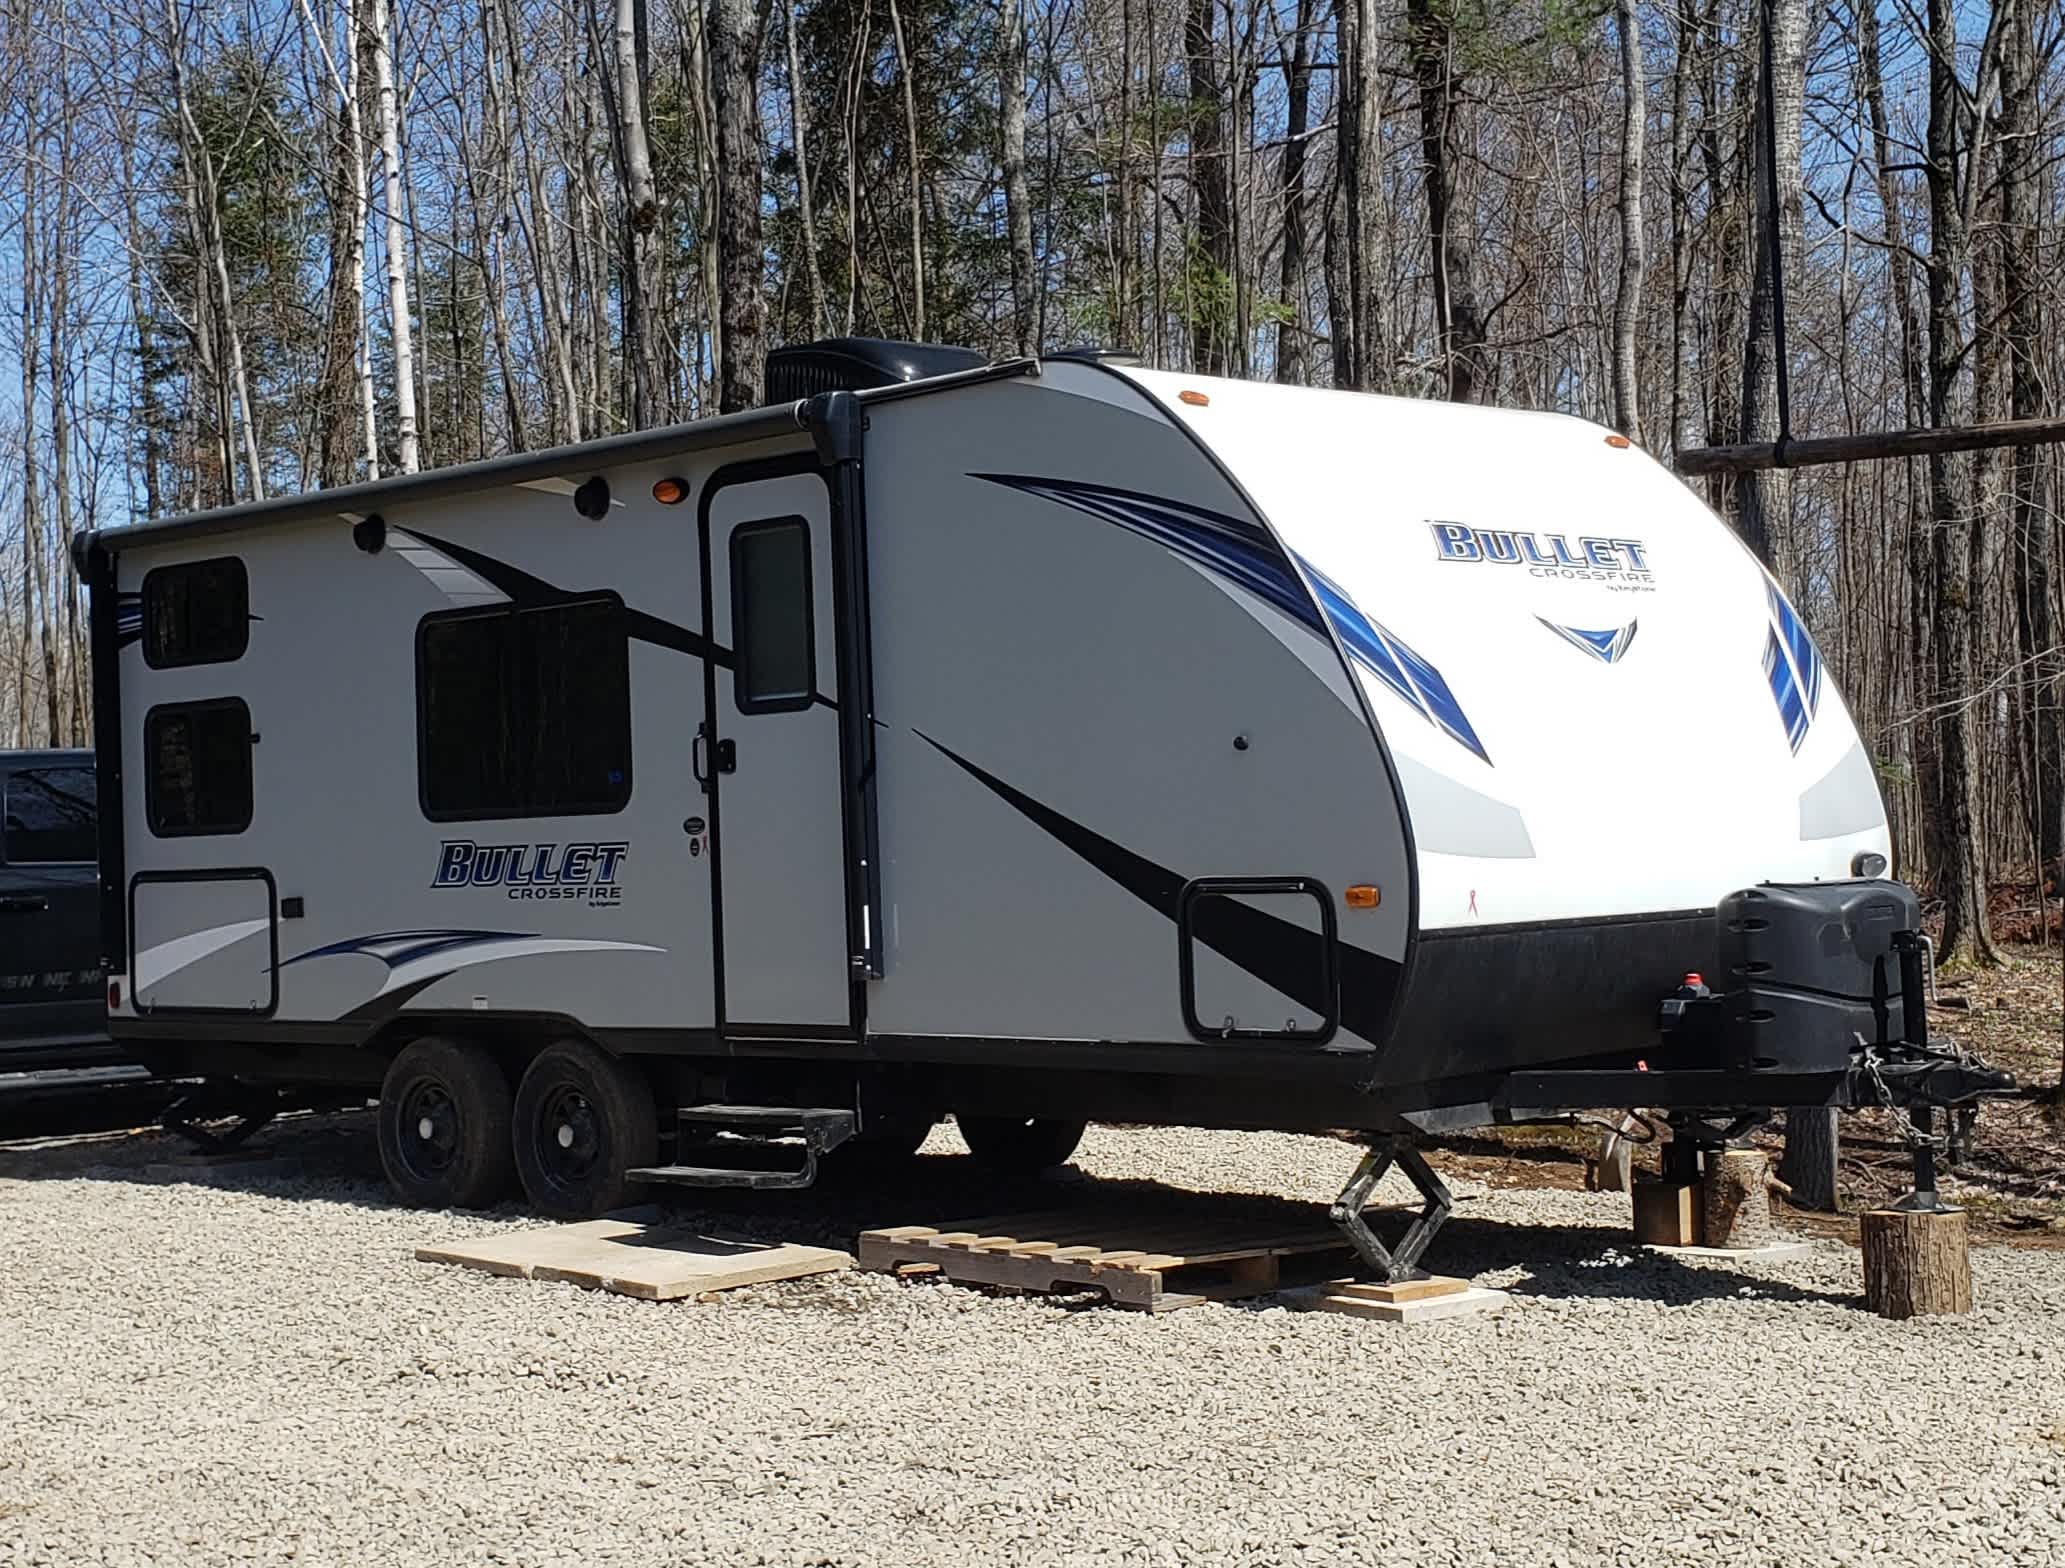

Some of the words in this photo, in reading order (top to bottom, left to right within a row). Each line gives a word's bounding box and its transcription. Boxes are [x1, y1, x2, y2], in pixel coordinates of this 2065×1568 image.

[1424, 519, 1651, 572] BULLET
[1529, 567, 1656, 583] CROSSFIRE
[430, 840, 629, 888] BULLET
[508, 886, 622, 900] CROSSFIRE
